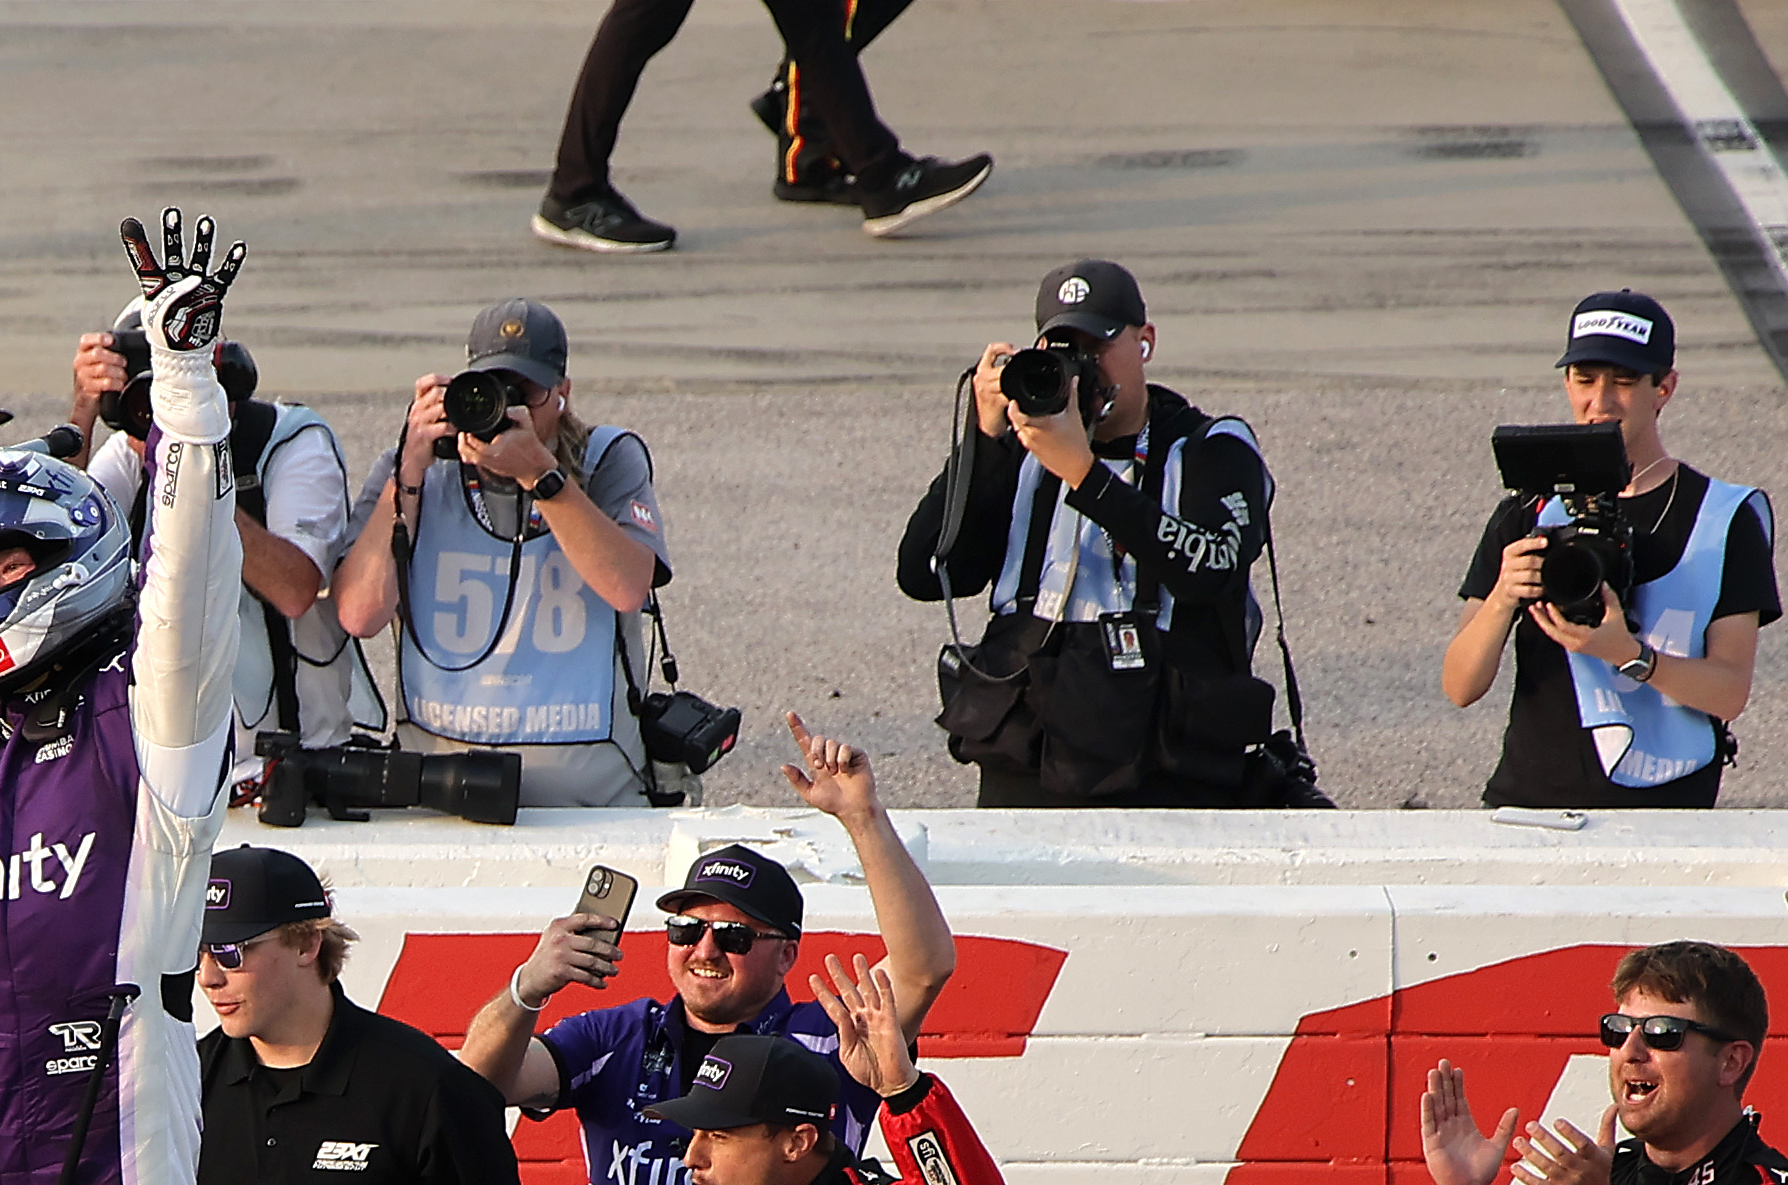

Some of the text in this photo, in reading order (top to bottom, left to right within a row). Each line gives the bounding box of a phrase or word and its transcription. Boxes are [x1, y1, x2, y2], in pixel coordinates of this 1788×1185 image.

[161, 442, 185, 508] sparco
[433, 551, 590, 655] 578
[414, 696, 603, 734] LICENSED MEDIA
[701, 861, 750, 881] xfinity
[45, 1055, 100, 1075] sparc
